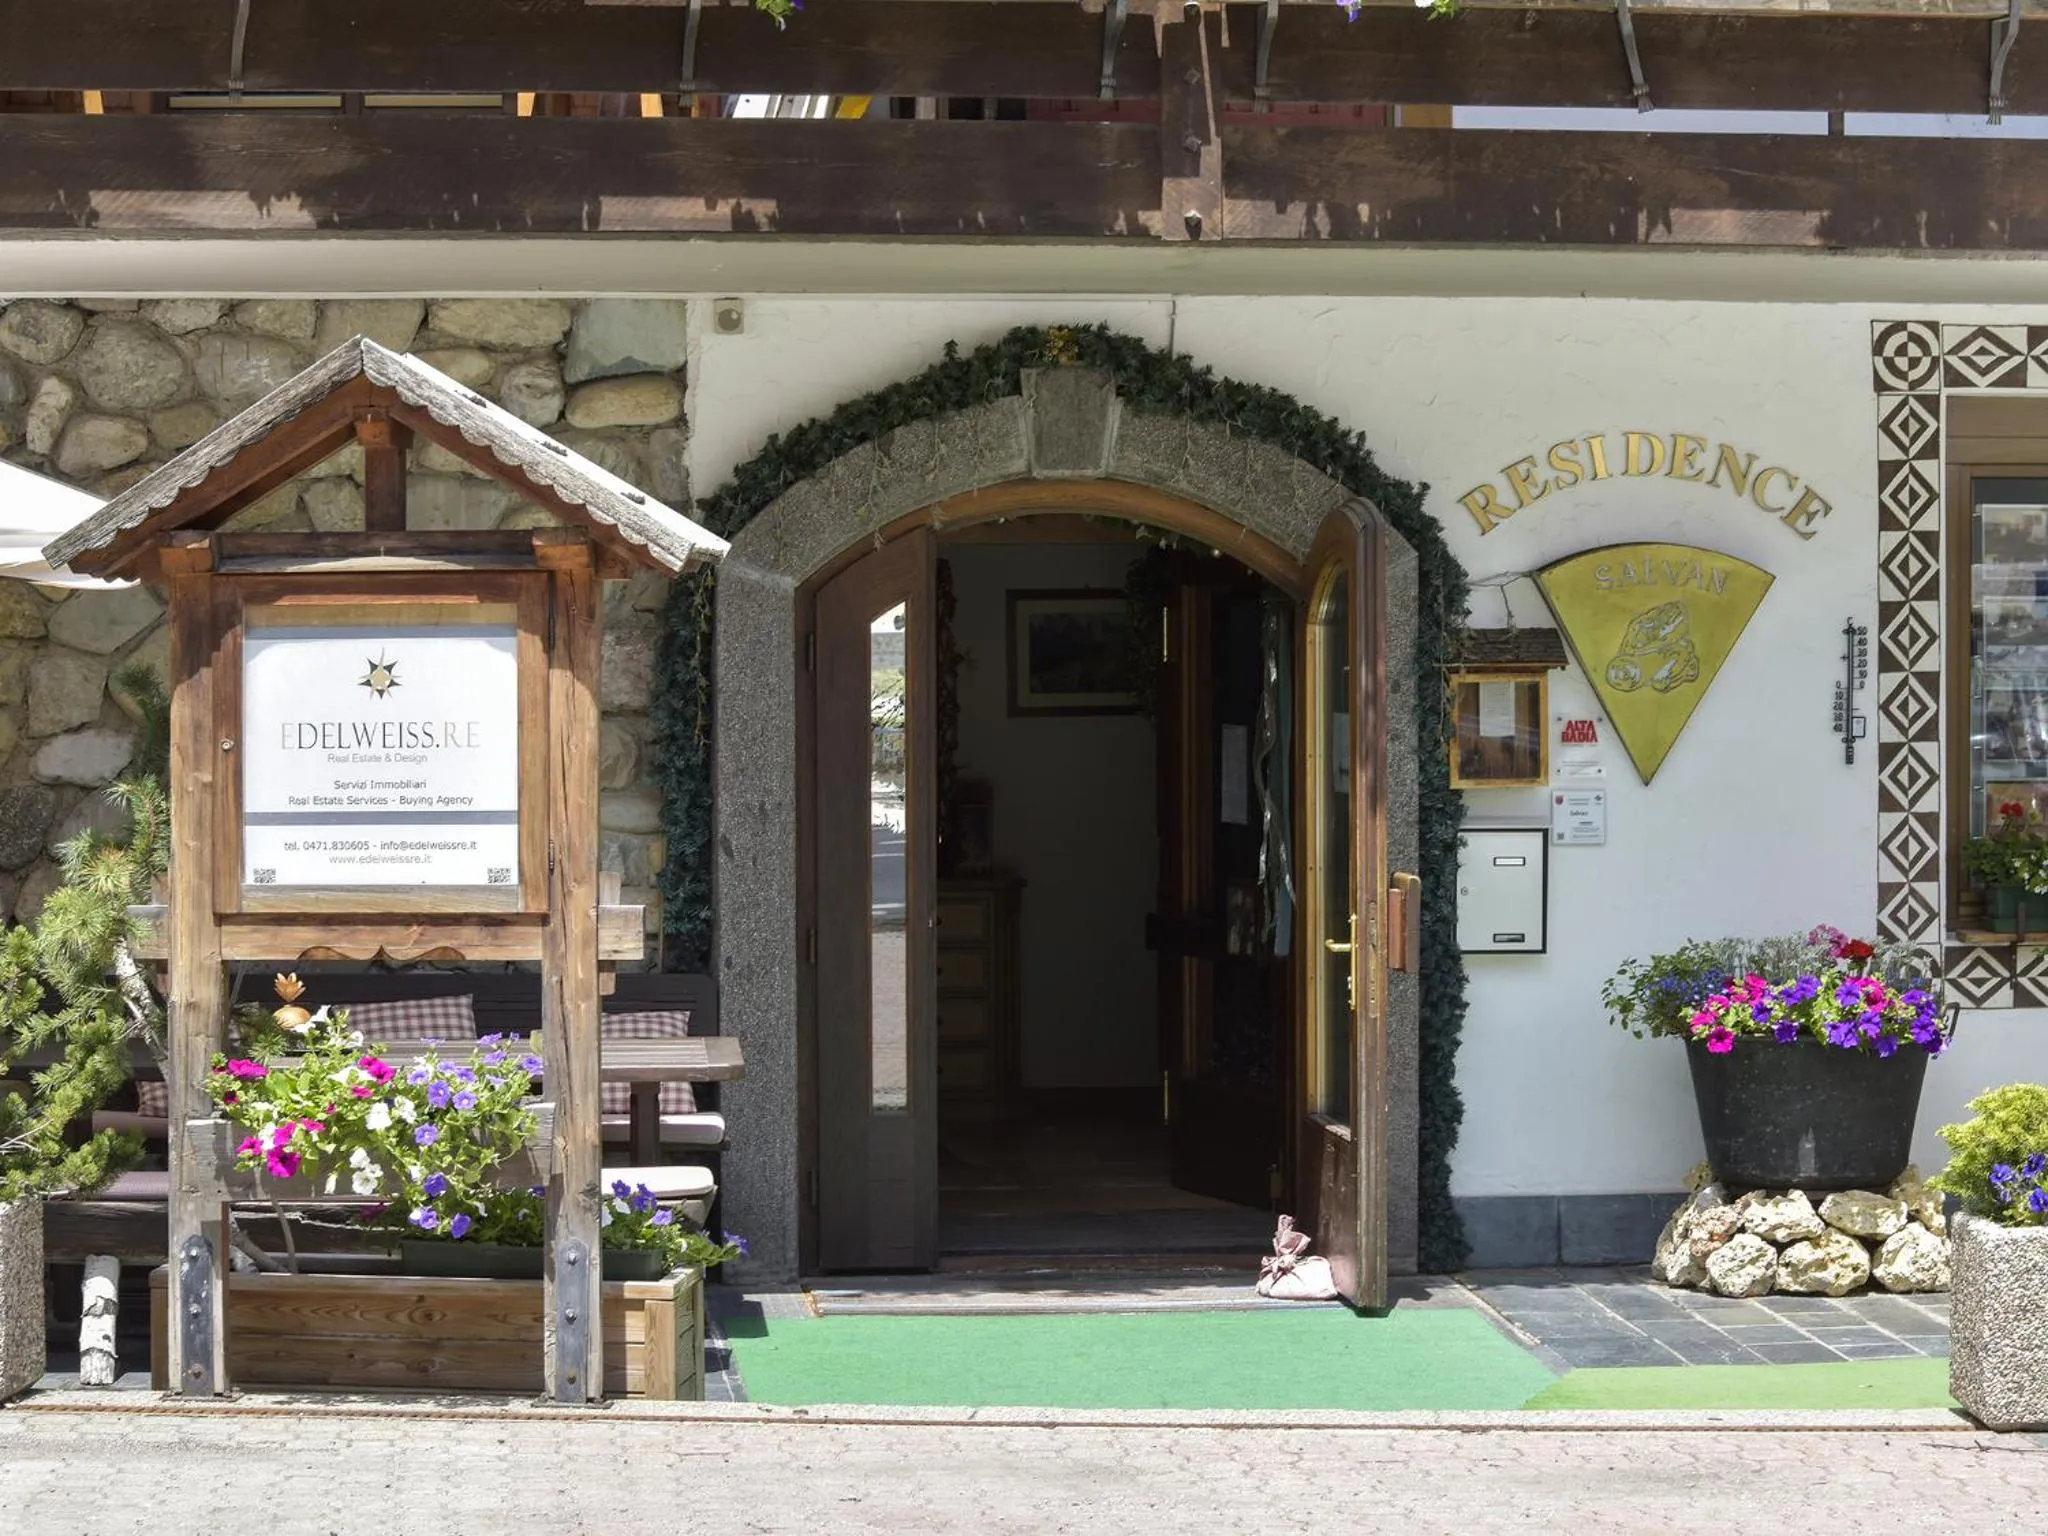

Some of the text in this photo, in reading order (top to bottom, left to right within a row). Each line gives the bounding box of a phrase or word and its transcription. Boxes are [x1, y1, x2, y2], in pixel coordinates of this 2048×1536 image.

[1457, 431, 1833, 541] RESIDENCE
[1594, 554, 1730, 595] SALVAN
[1566, 720, 1595, 731] ALTA
[281, 721, 480, 749] EDELWEISS.RE
[1561, 731, 1598, 743] BADIA
[327, 753, 428, 765] Real Estate & Design
[333, 779, 427, 790] Servizi Immobiliari
[288, 796, 310, 806] Real
[313, 796, 344, 806] Estate
[347, 795, 389, 805] Services
[399, 795, 433, 807] Buying
[436, 795, 474, 807] Agency
[284, 841, 300, 852] tel.
[303, 840, 370, 851] 0471.830605
[380, 840, 478, 851] info@edelweissre.it
[329, 854, 433, 864] www.edelweissre.it
